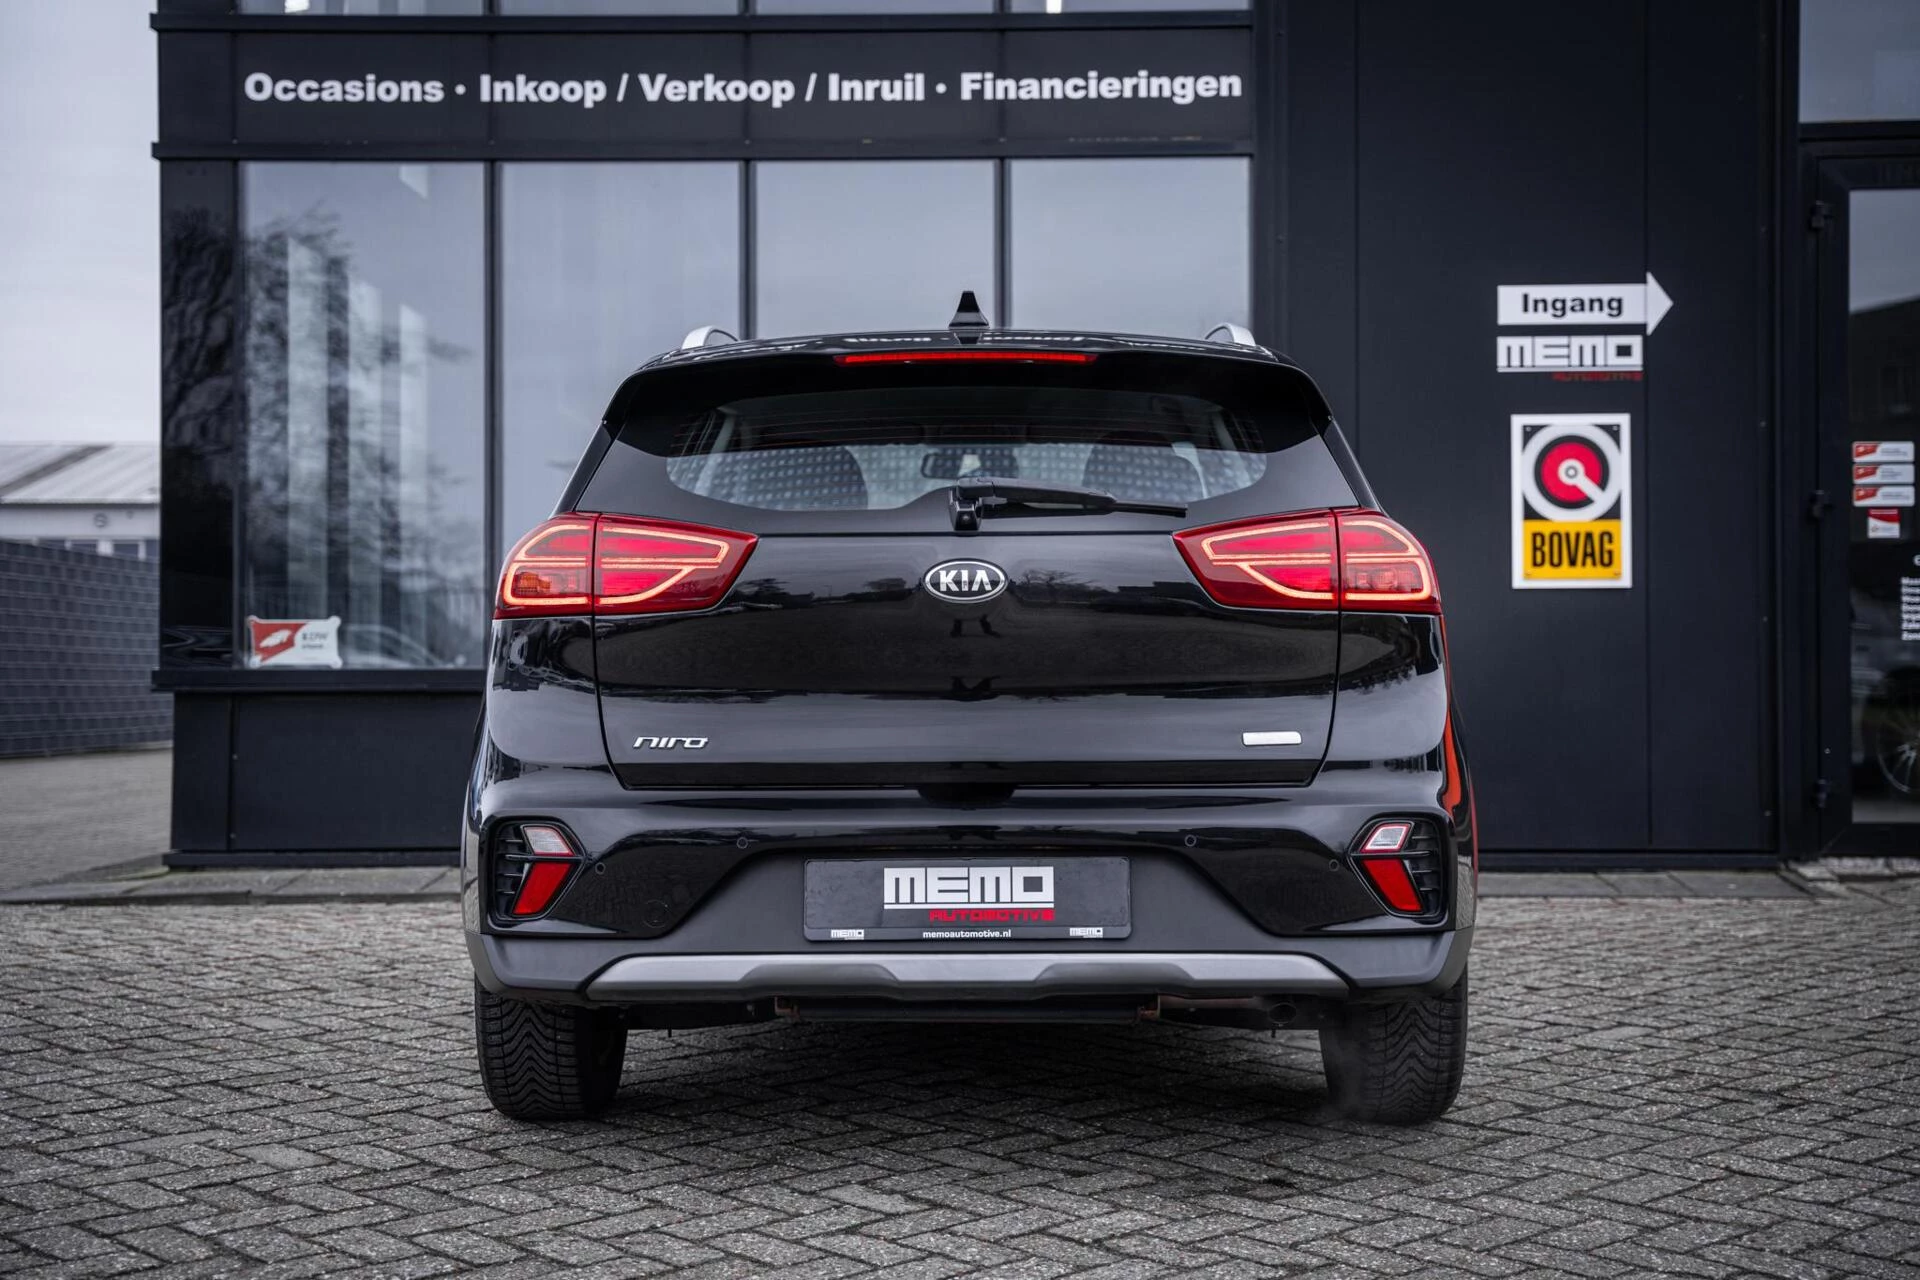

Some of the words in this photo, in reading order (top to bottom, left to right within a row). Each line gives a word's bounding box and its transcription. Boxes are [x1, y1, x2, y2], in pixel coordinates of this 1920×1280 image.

[244, 73, 444, 102] Occasions
[479, 74, 607, 108] Inkoop
[637, 74, 796, 108] Verkoop
[828, 73, 925, 101] Inruil
[960, 70, 1242, 105] Financieringen
[1522, 293, 1623, 318] Ingang
[1531, 531, 1614, 568] BOVAG
[939, 569, 992, 592] KIA
[929, 909, 1055, 922] AUTOMOTIVE
[923, 929, 1011, 938] memoautomotive.nl
